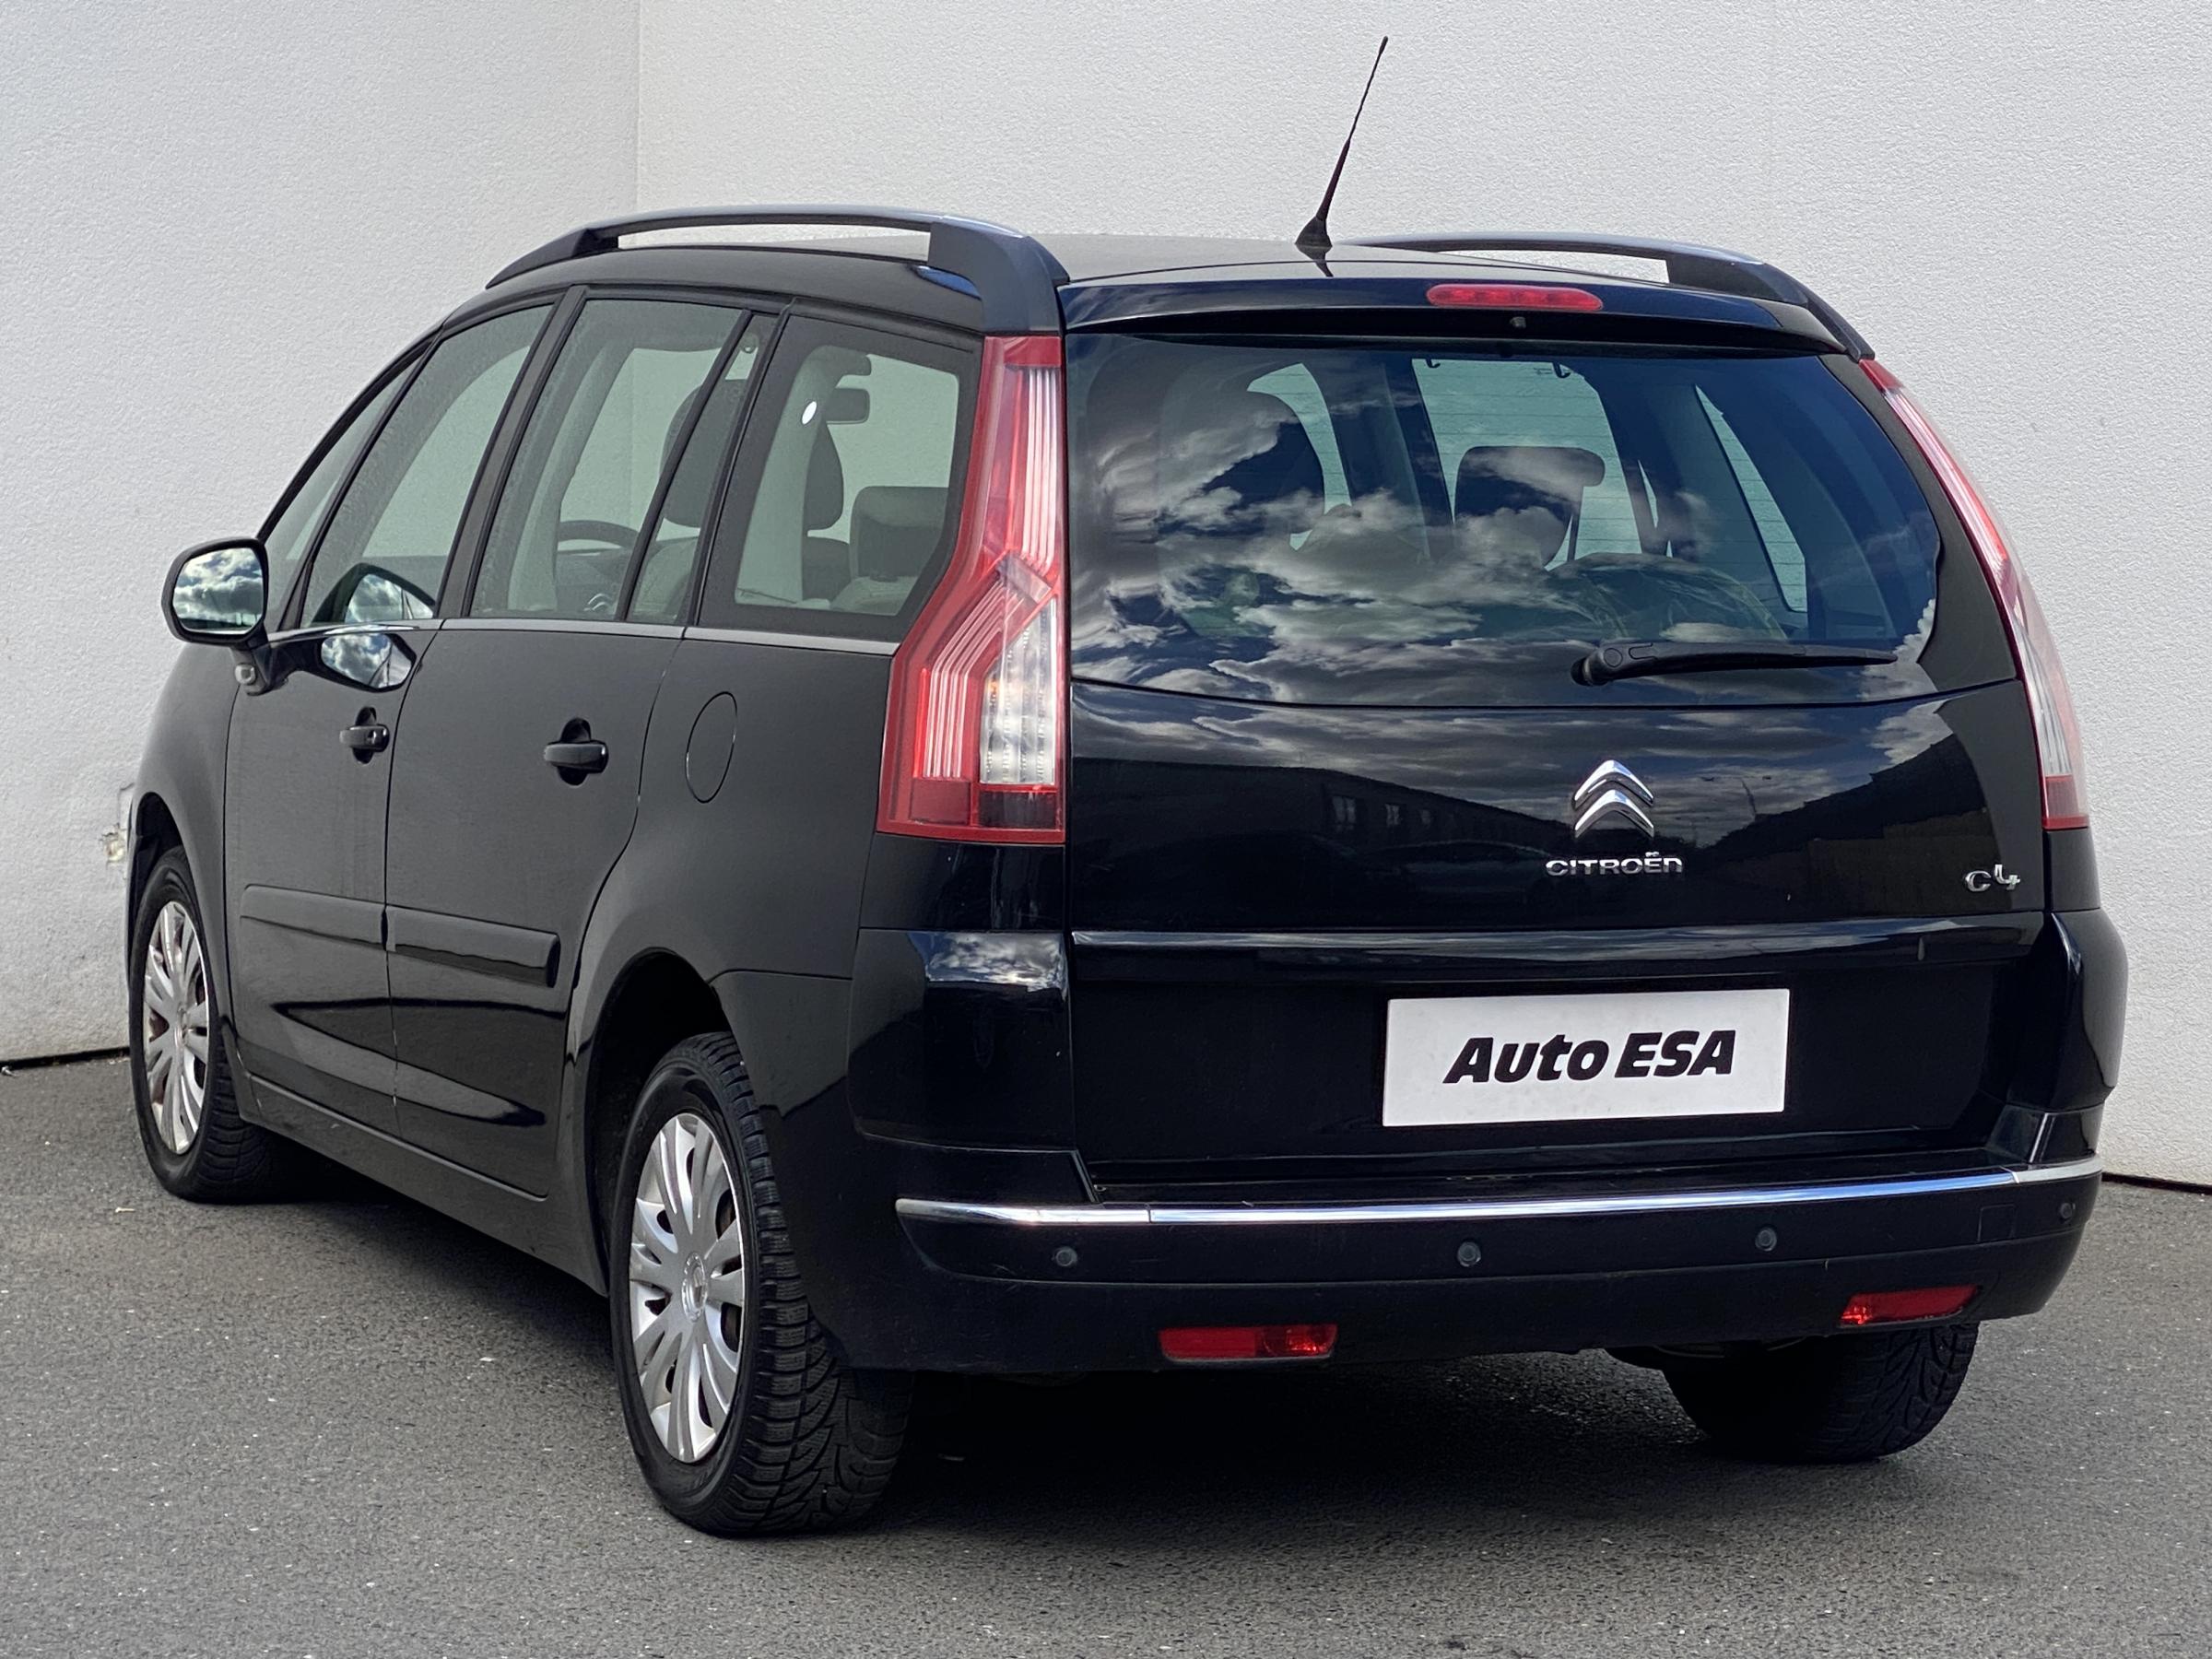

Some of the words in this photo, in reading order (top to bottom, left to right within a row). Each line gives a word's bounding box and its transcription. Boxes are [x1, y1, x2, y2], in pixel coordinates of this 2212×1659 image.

[1964, 864, 2021, 892] C4
[1442, 1034, 1610, 1084] Auto
[1614, 1030, 1736, 1078] ESA
